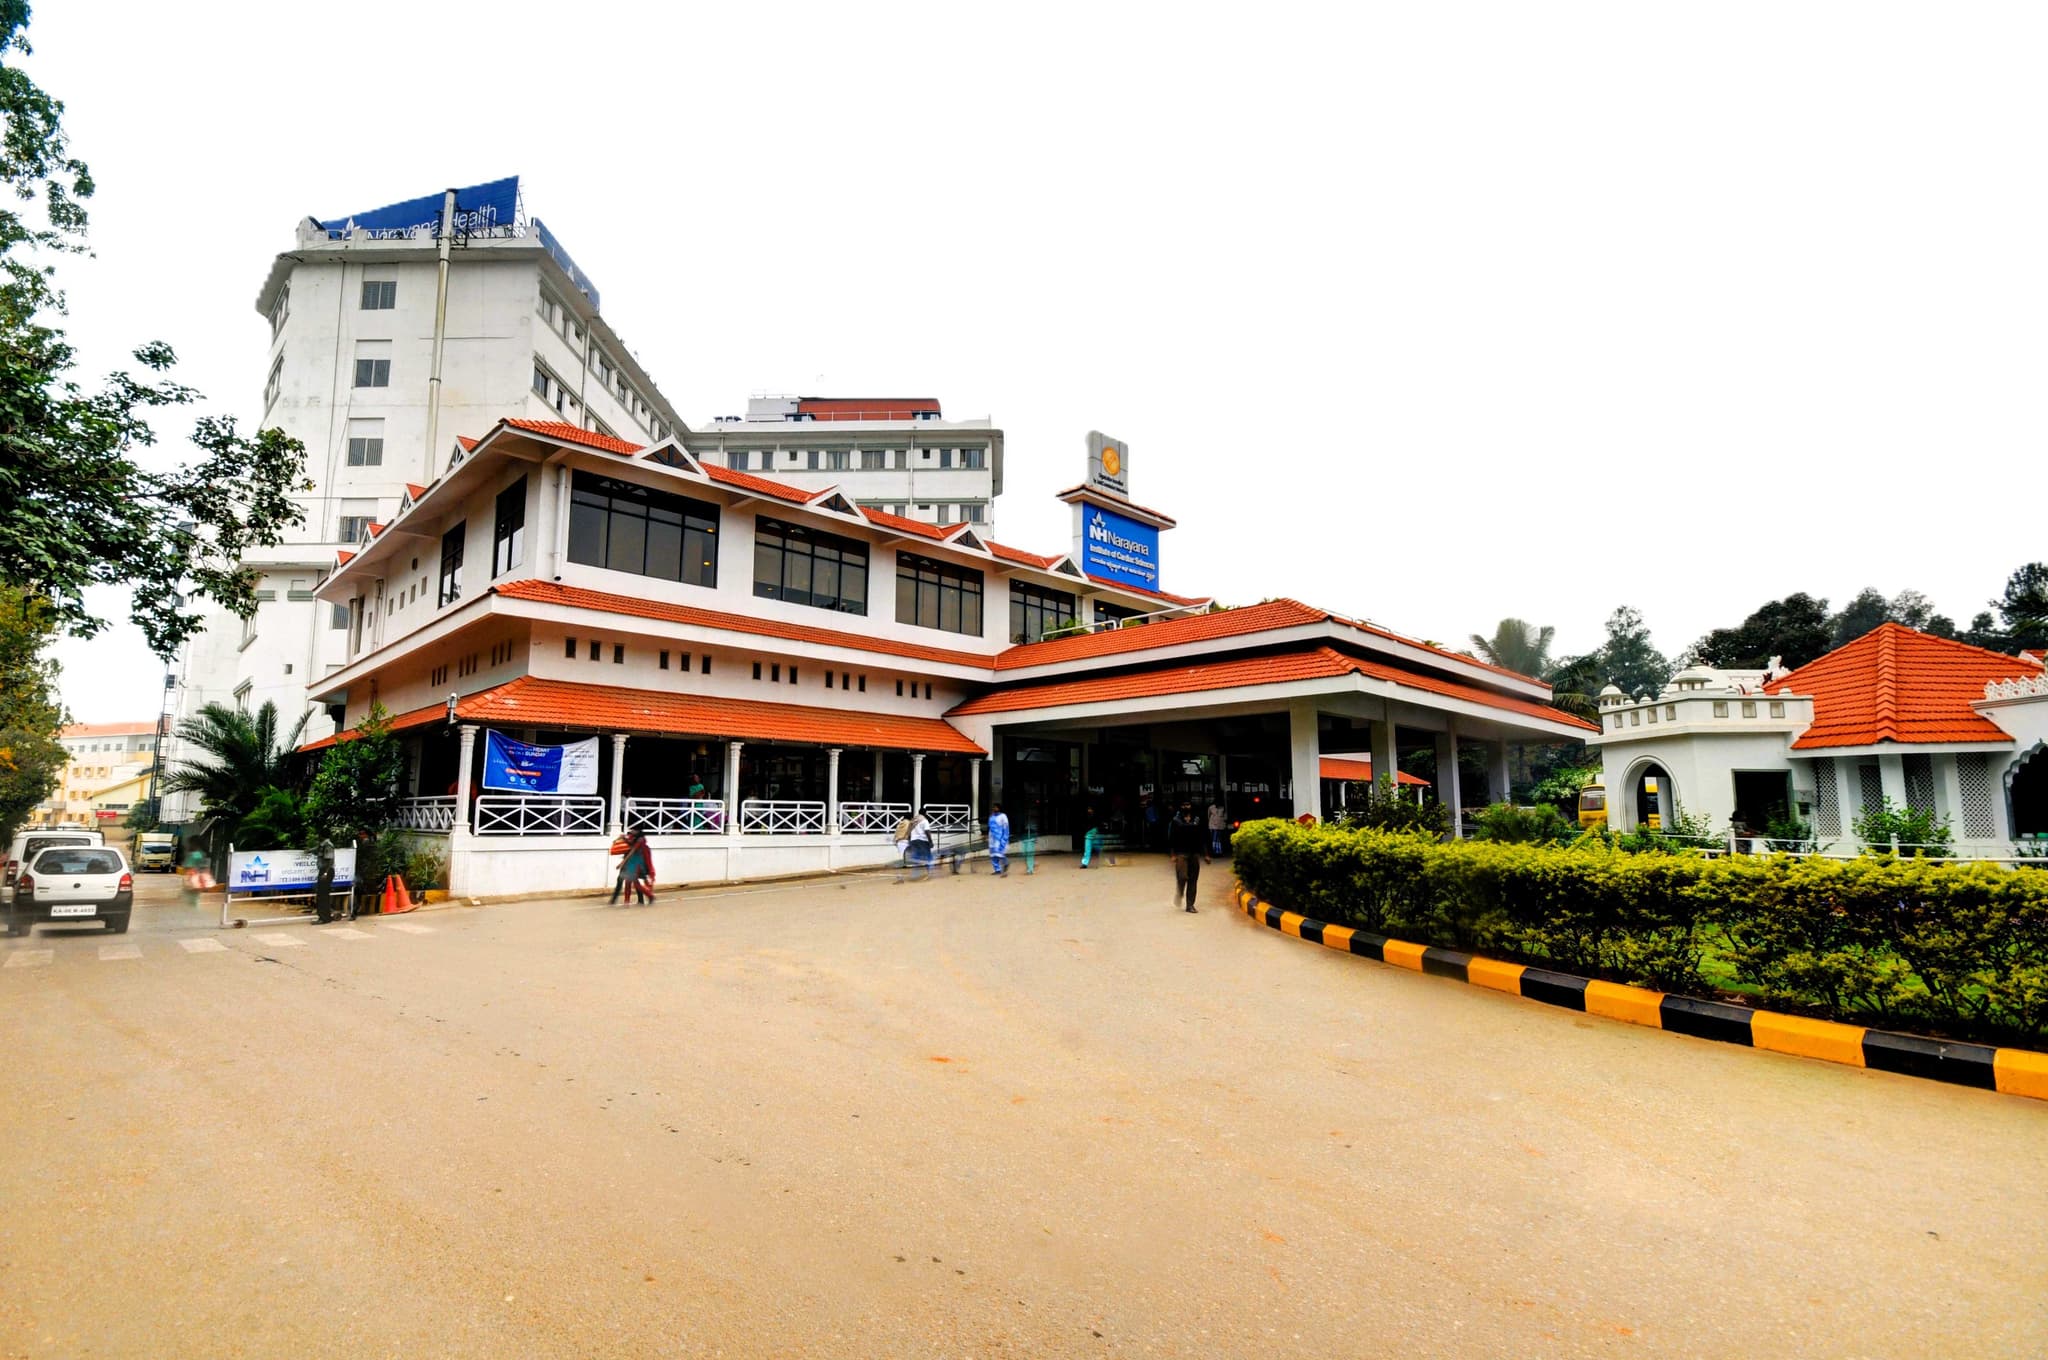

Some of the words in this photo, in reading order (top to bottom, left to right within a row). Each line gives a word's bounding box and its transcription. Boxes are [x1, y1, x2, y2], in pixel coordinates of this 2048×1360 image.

[452, 203, 497, 228] Health
[1089, 524, 1107, 543] NH
[1108, 530, 1149, 556] Narayana
